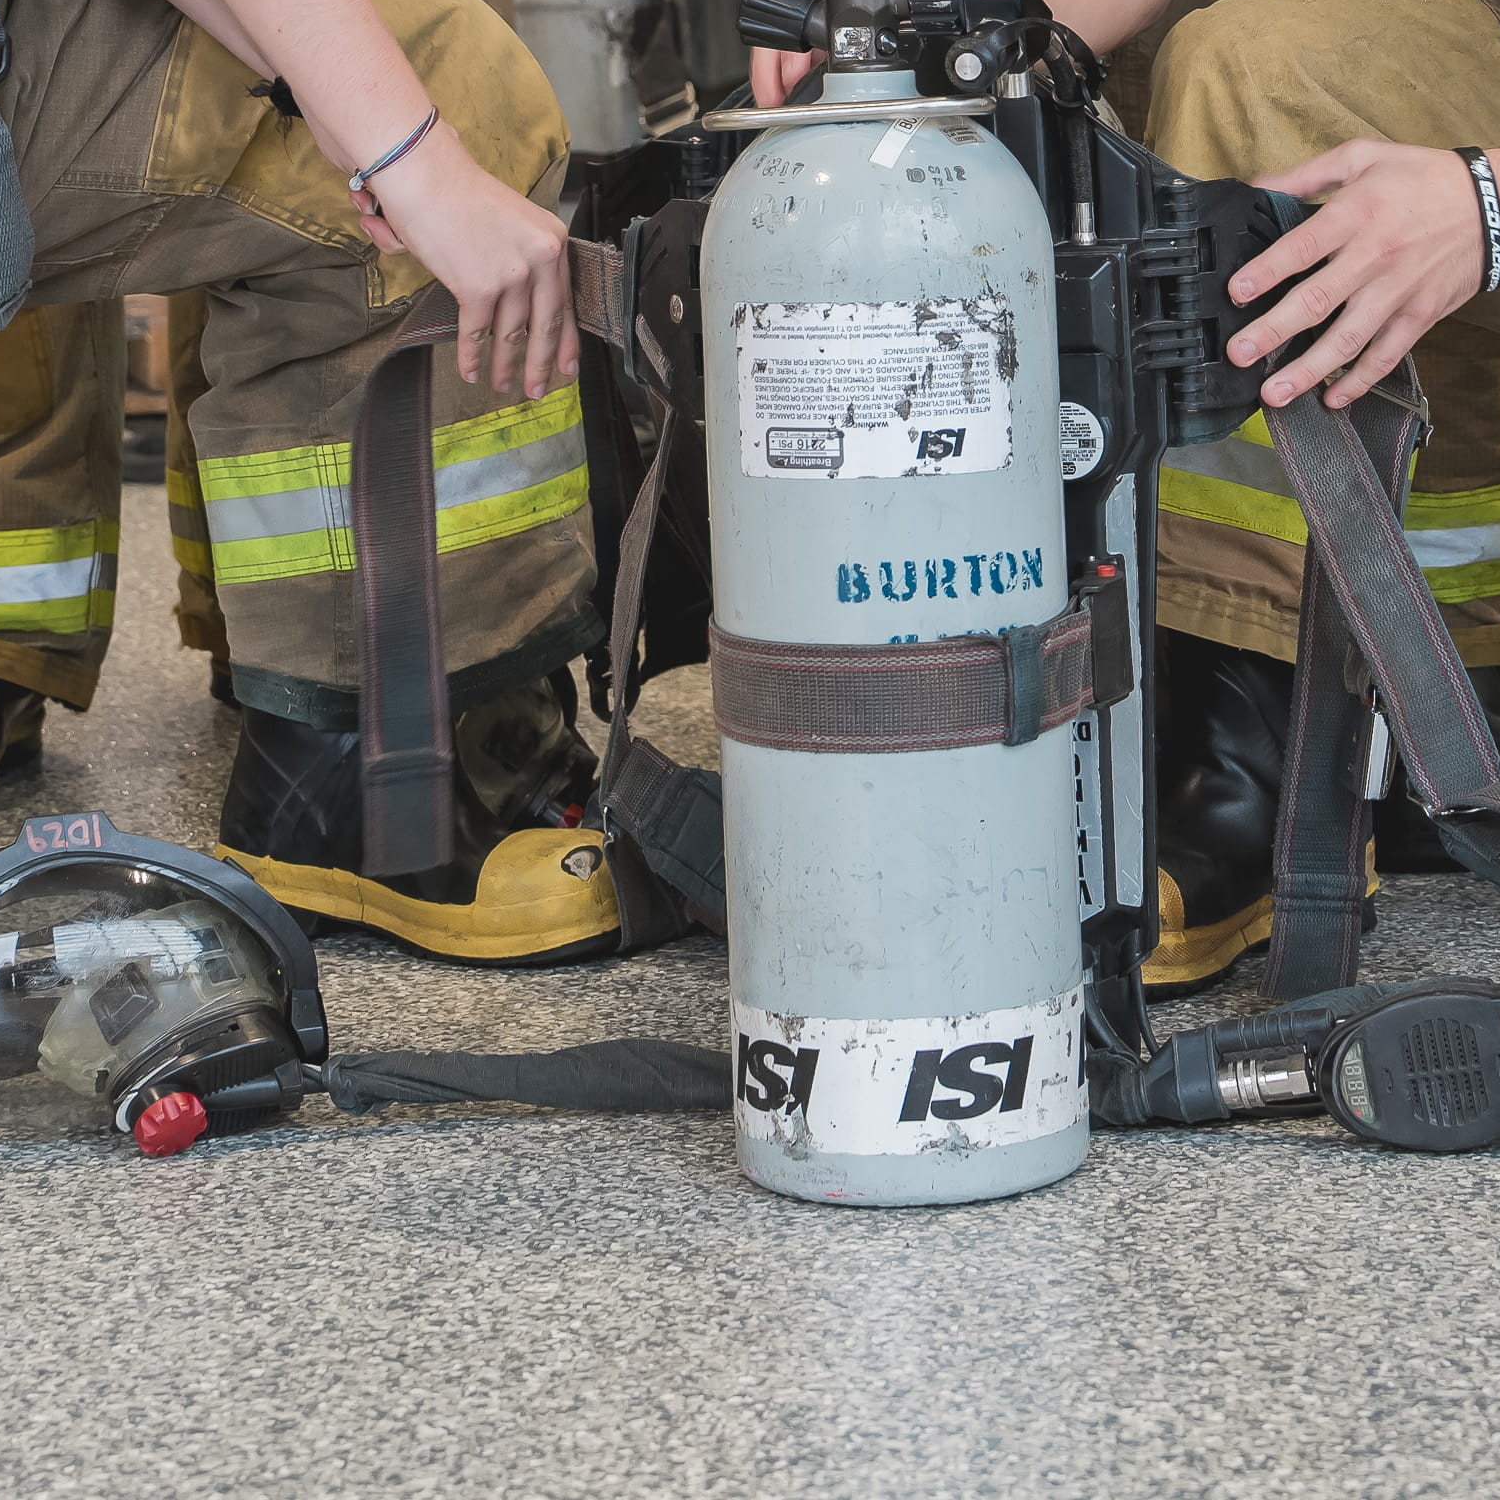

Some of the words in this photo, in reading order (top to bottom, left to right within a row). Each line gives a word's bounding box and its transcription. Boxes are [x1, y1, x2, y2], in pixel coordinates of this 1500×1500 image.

[878, 356, 924, 364] SUITABILITY
[876, 366, 922, 374] STANDARDS
[754, 376, 797, 384] COMPRESSED
[755, 385, 791, 393] GUIDELINES
[913, 400, 944, 408] CYLINDE
[910, 410, 932, 418] CHEC
[970, 406, 990, 414] AFTER
[778, 440, 793, 448] PSI
[797, 439, 826, 449] 2216
[916, 428, 966, 460] ISI
[790, 456, 831, 467] Breathing
[836, 548, 1045, 604] BURTON
[898, 1033, 1033, 1122] ISI
